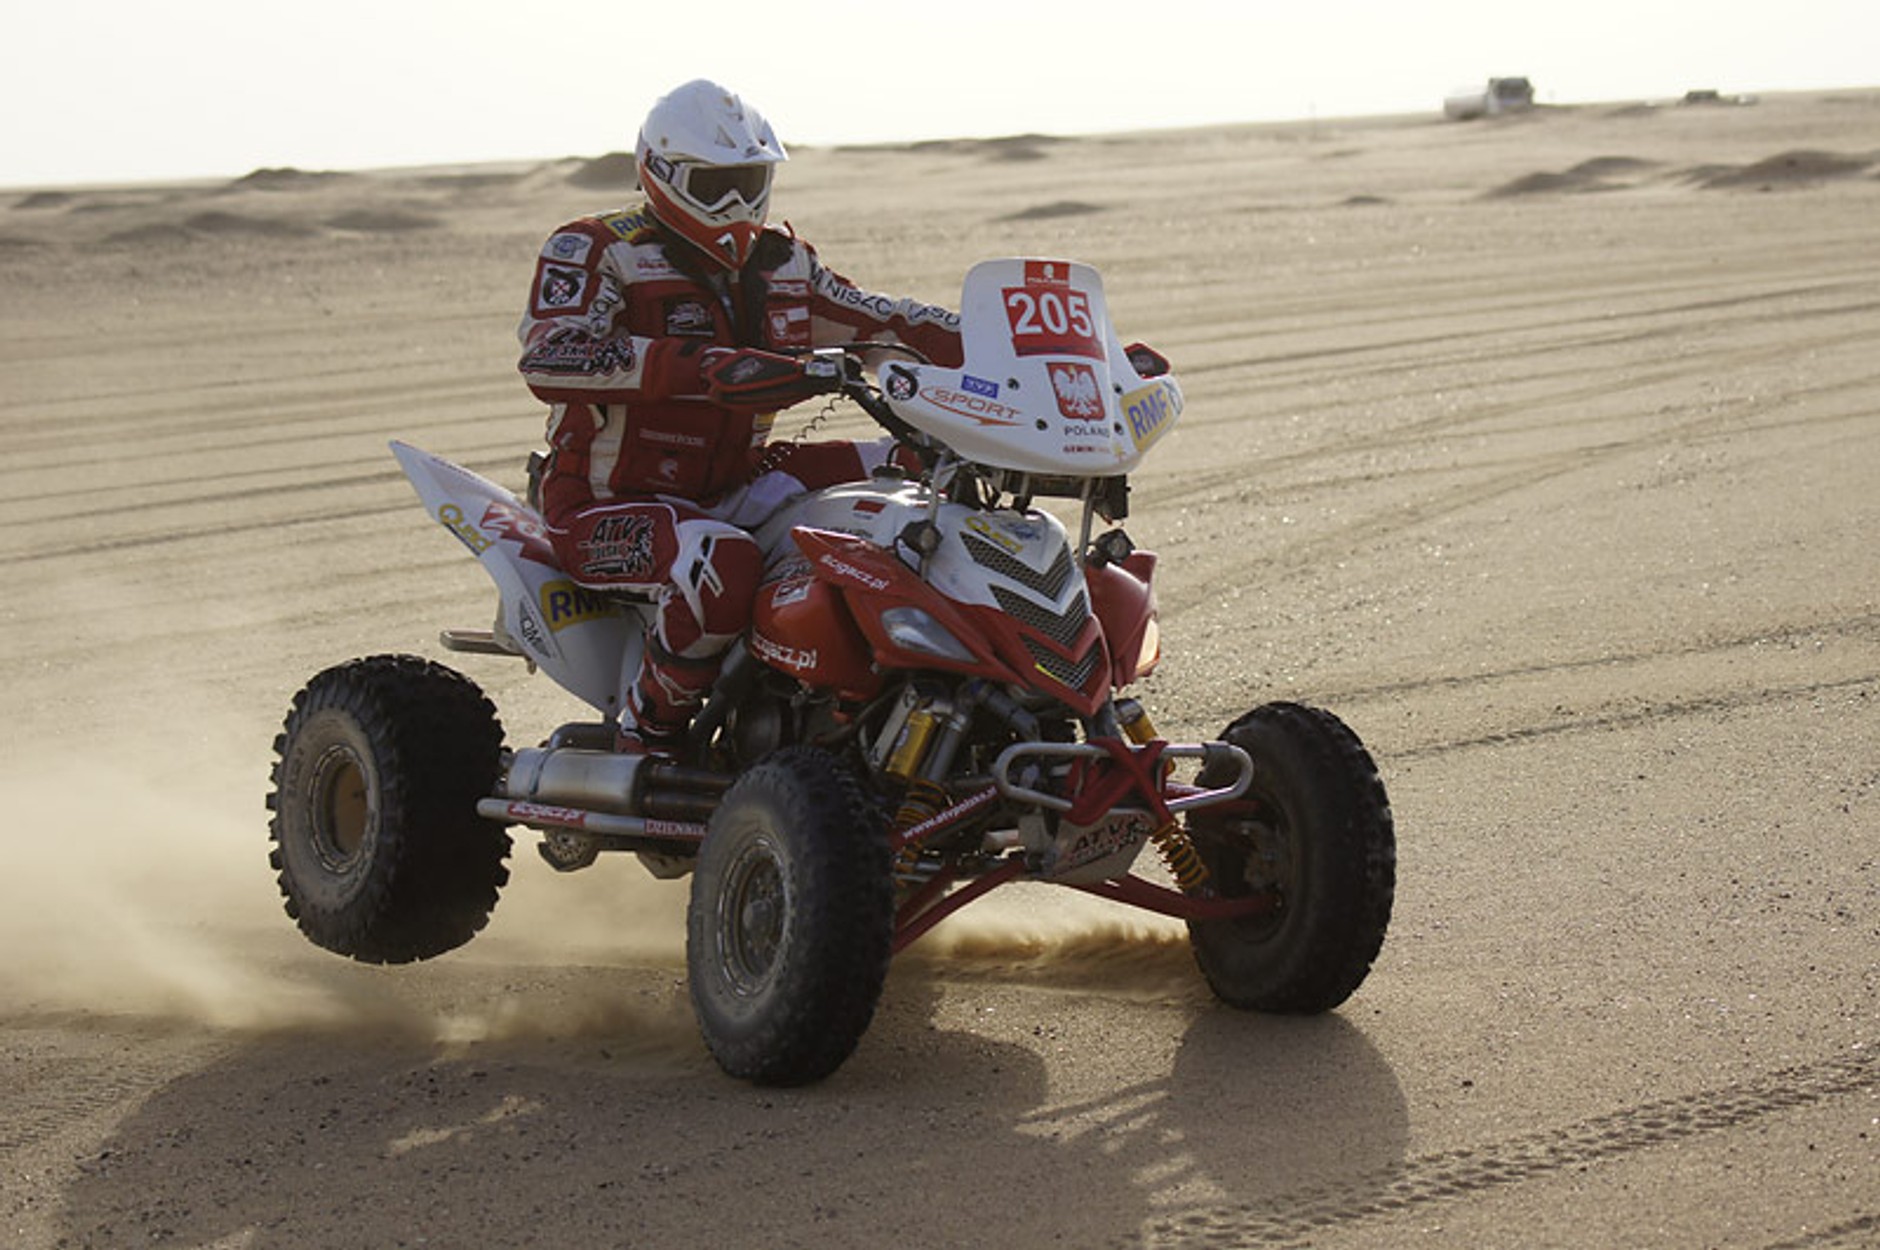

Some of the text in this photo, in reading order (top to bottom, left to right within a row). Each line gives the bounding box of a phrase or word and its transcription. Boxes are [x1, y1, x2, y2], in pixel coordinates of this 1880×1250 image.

[1008, 291, 1092, 338] 205
[934, 387, 1022, 418] SPORT
[1127, 387, 1168, 440] RMF
[1064, 425, 1110, 438] POLAND
